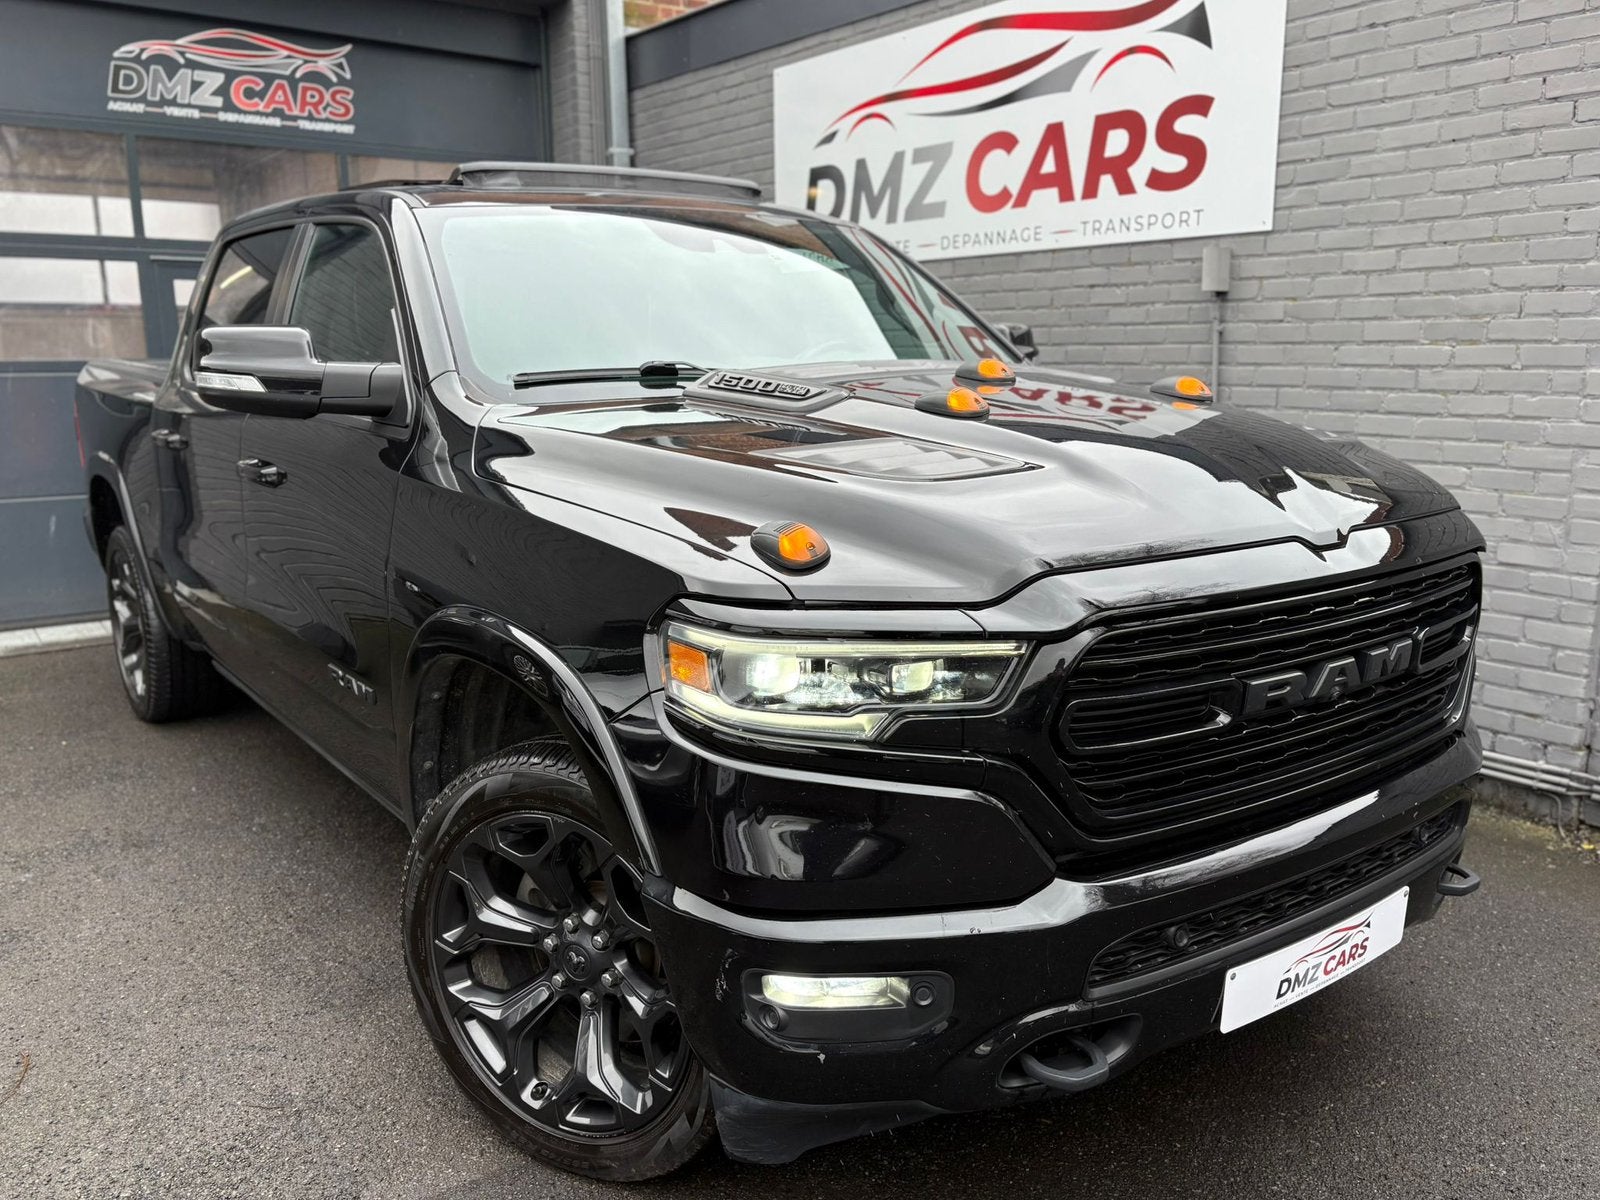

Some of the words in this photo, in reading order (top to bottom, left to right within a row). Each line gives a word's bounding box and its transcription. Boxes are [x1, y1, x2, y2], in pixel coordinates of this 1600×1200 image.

[107, 60, 226, 108] DMZ
[230, 75, 355, 121] CARS
[806, 141, 954, 225] DMZ
[966, 94, 1215, 213] CARS
[940, 226, 1043, 251] DEPANNAGE
[1080, 209, 1205, 237] TRANSPORT
[713, 374, 779, 394] 1500
[1243, 638, 1413, 714] RAM
[1276, 961, 1323, 1000] DMZ
[1323, 937, 1370, 977] CARS
